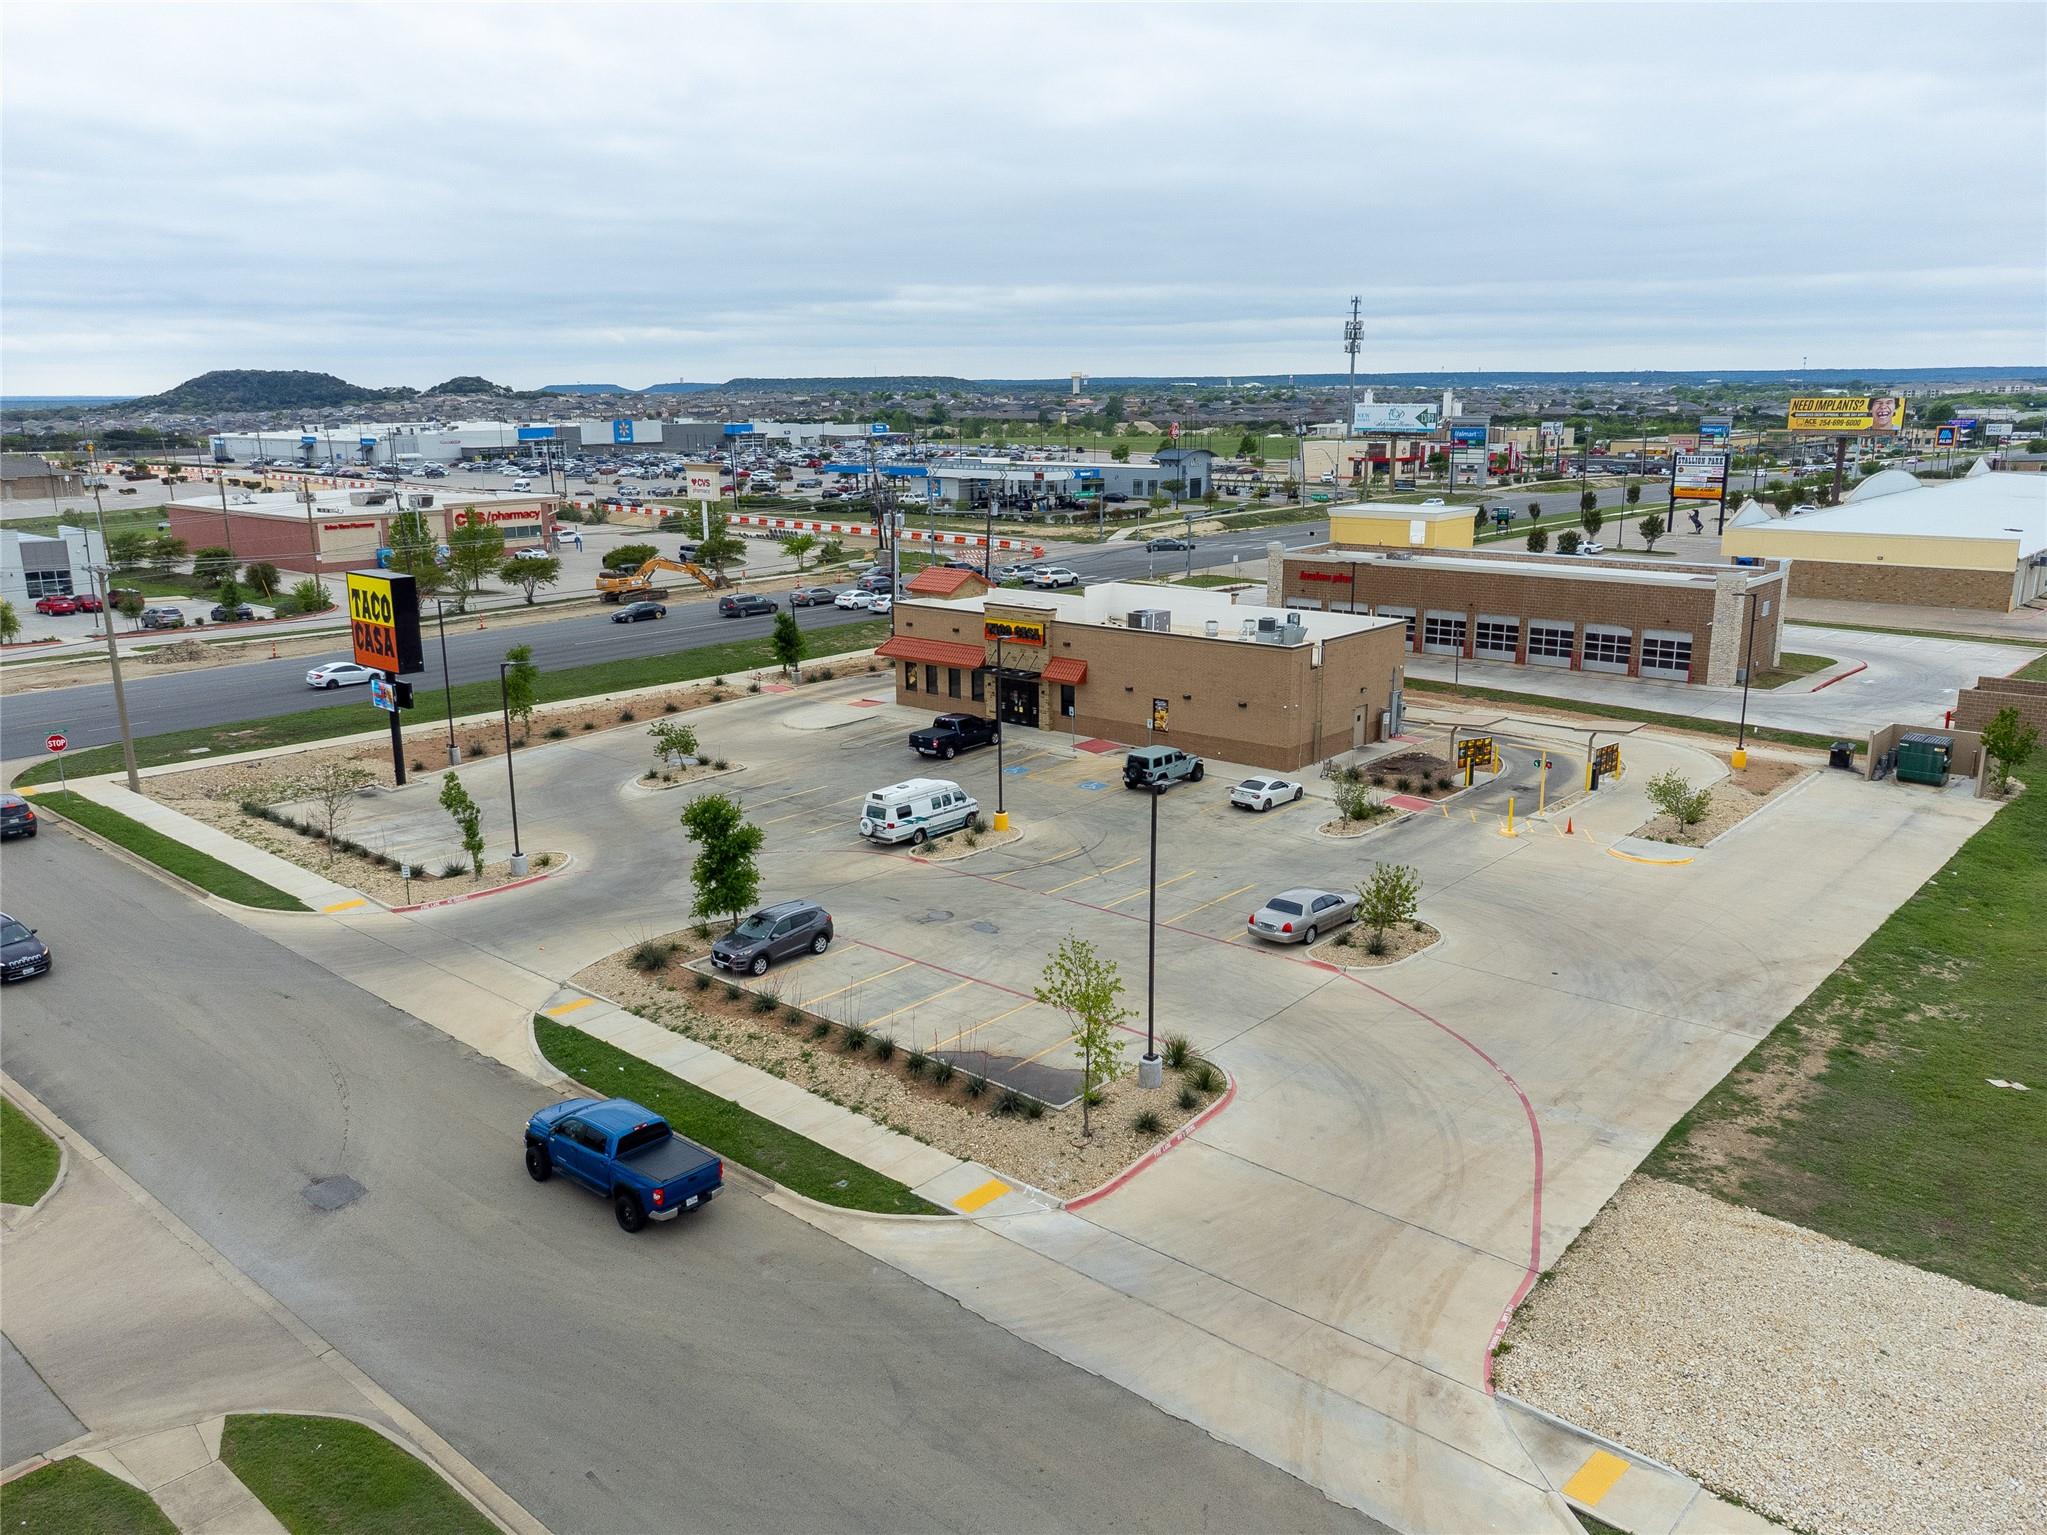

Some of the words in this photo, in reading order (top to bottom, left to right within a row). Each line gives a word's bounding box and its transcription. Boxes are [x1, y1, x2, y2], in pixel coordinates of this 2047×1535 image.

[1792, 400, 1813, 411] NEED
[1815, 399, 1865, 411] IMPLANTS?
[1677, 457, 1706, 465] STALLION
[1707, 457, 1724, 465] PARK
[697, 478, 711, 487] CVS
[352, 589, 391, 623] TACO
[355, 622, 395, 657] CASA
[47, 739, 66, 748] STOP
